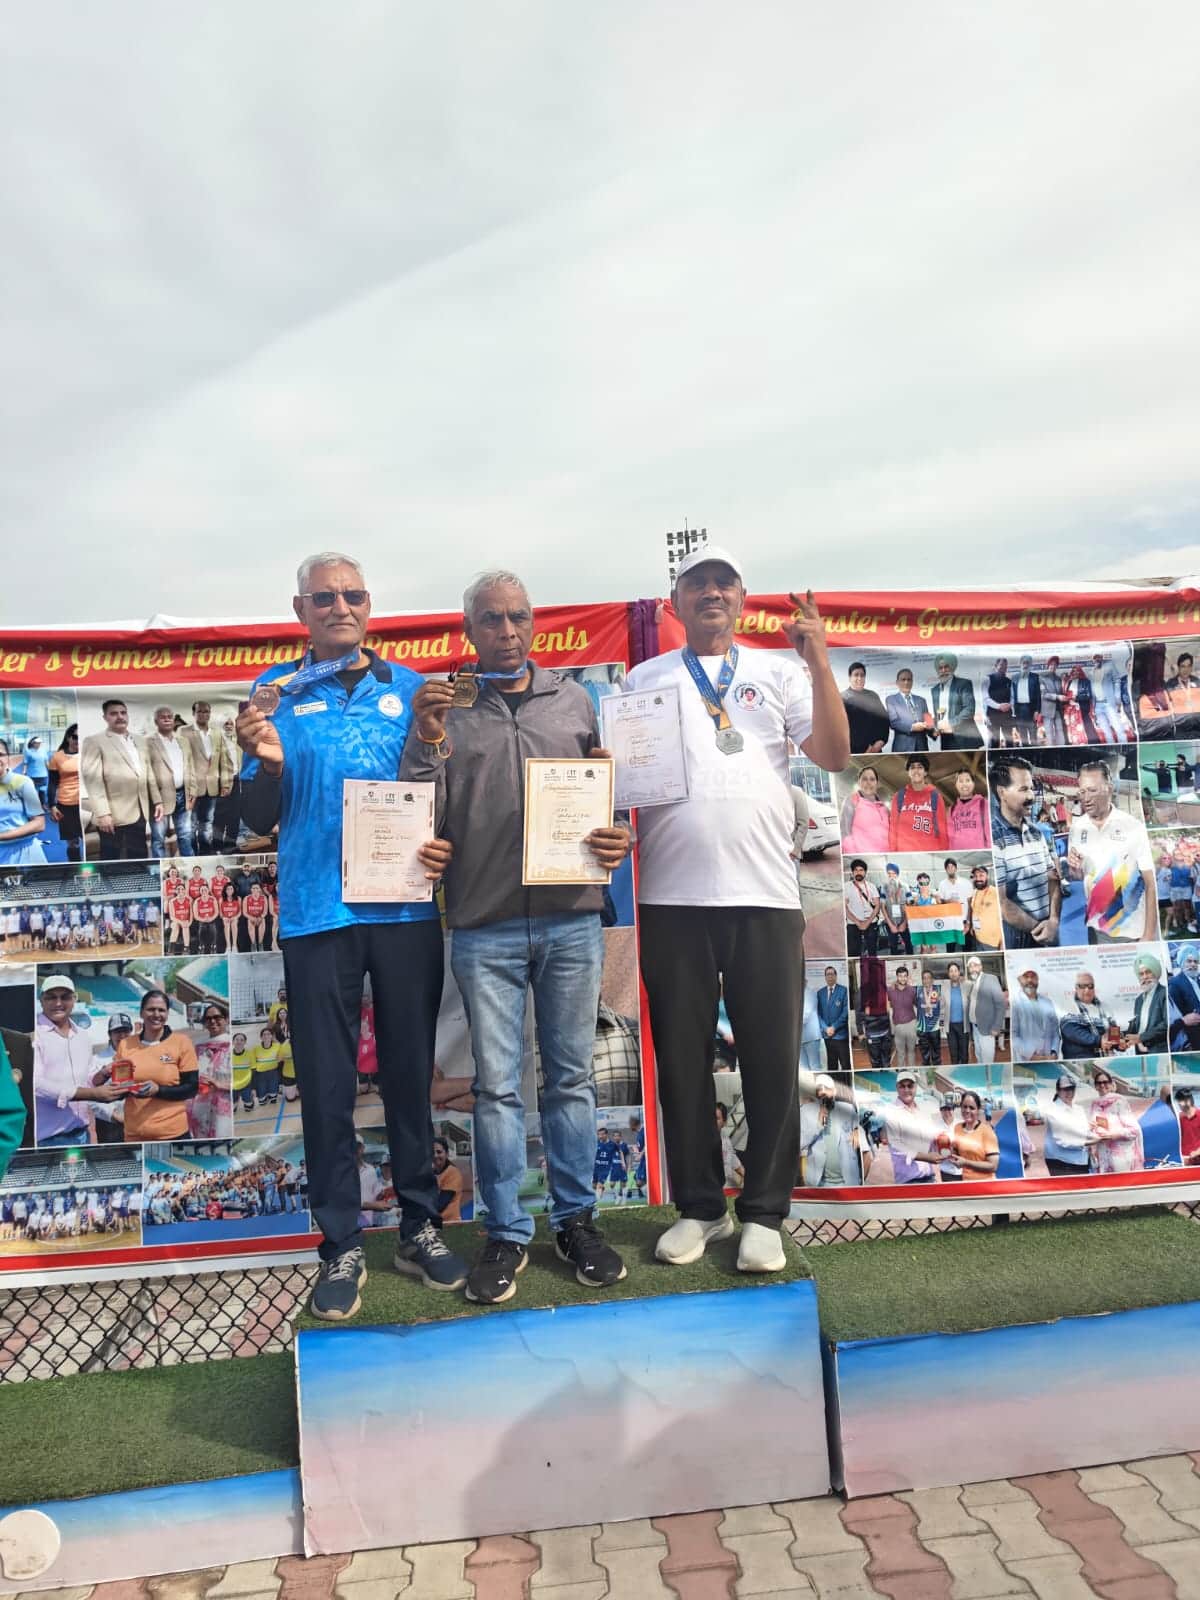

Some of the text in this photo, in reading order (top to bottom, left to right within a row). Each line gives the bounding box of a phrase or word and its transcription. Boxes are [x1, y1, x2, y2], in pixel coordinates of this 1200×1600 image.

[735, 609, 783, 635] elo
[789, 607, 908, 634] aster's
[917, 607, 1008, 639] Games
[71, 645, 175, 679] Games
[181, 639, 304, 668] Foundat
